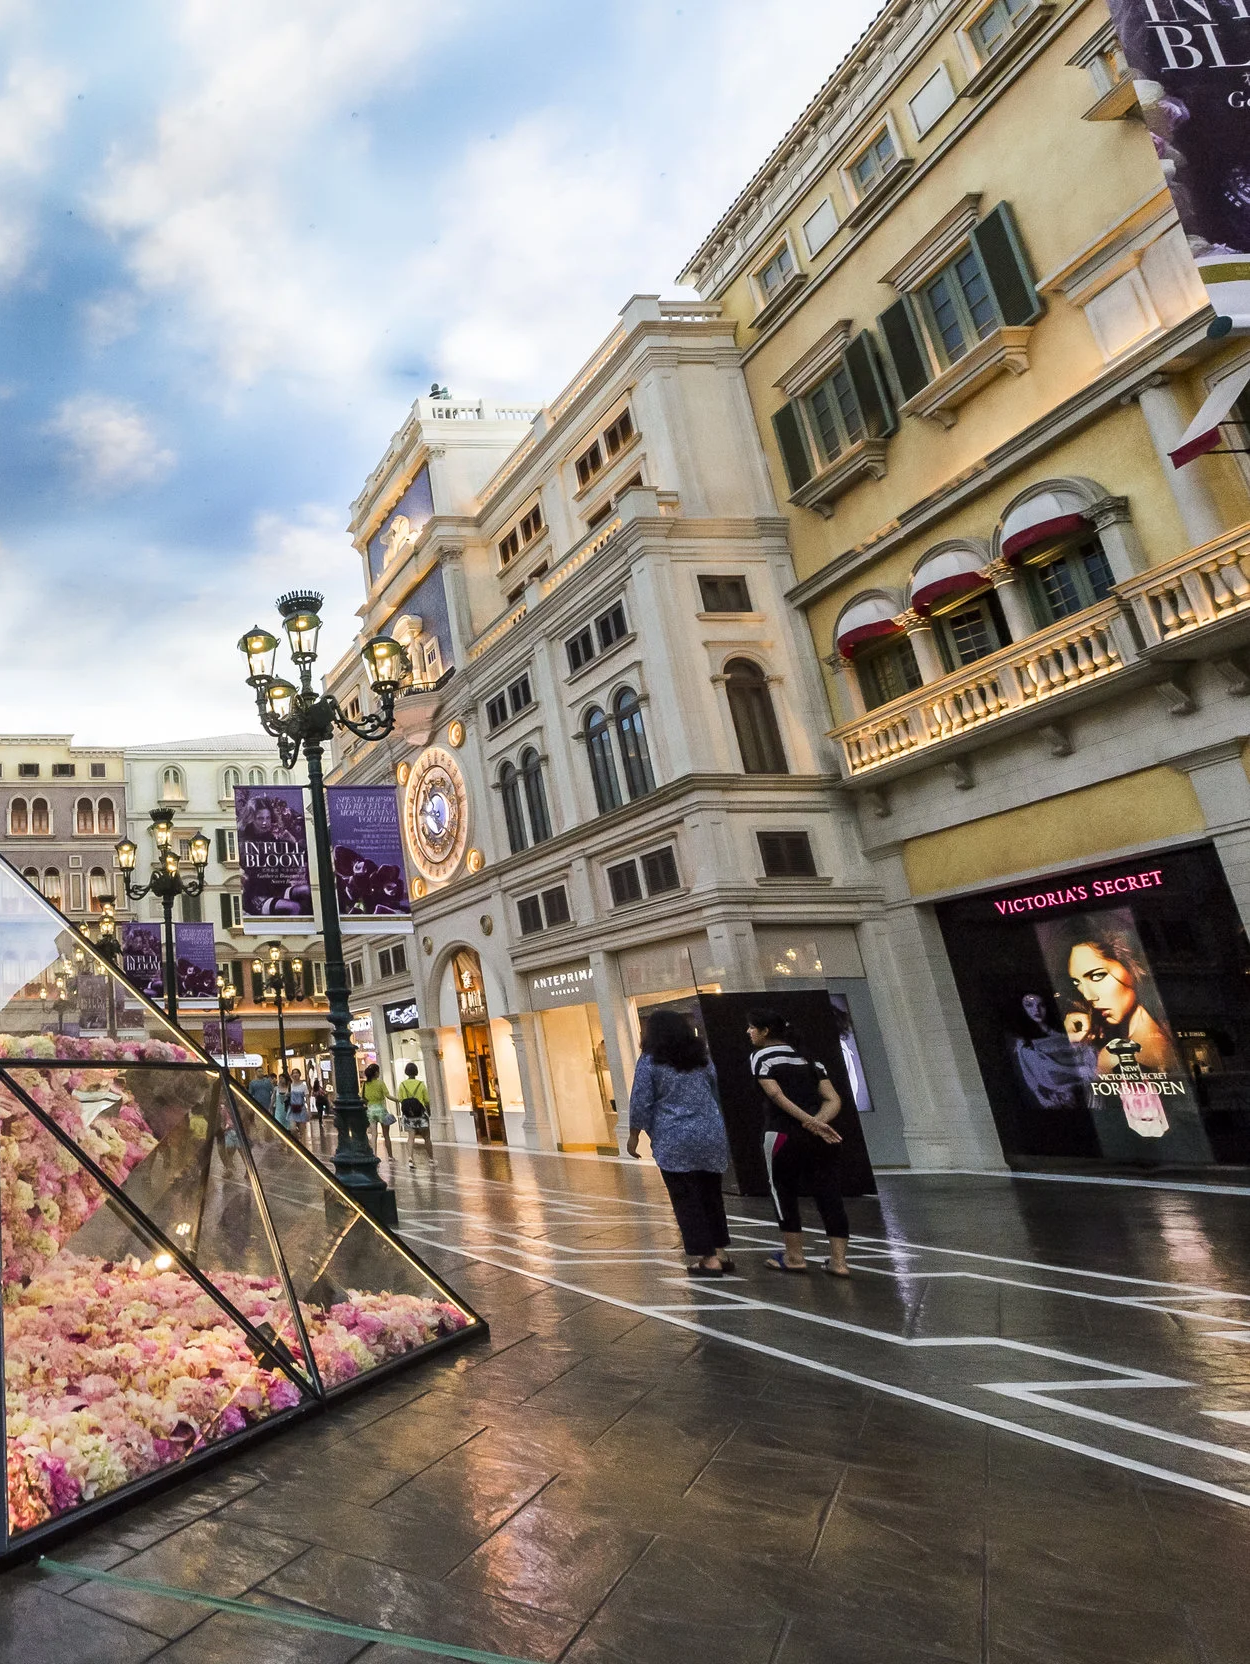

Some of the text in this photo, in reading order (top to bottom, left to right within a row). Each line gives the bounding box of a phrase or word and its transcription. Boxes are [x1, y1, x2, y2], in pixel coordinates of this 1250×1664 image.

[245, 841, 306, 854] IN FULL
[245, 854, 306, 867] BLOOM
[994, 870, 1163, 915] VICTORIA'S SECRET
[126, 961, 161, 971] BLOOM
[533, 968, 594, 990] ANTEPRIMA
[1098, 1072, 1168, 1081] VICTORIA'S SECRET
[1091, 1081, 1186, 1096] FORBIDDEN
